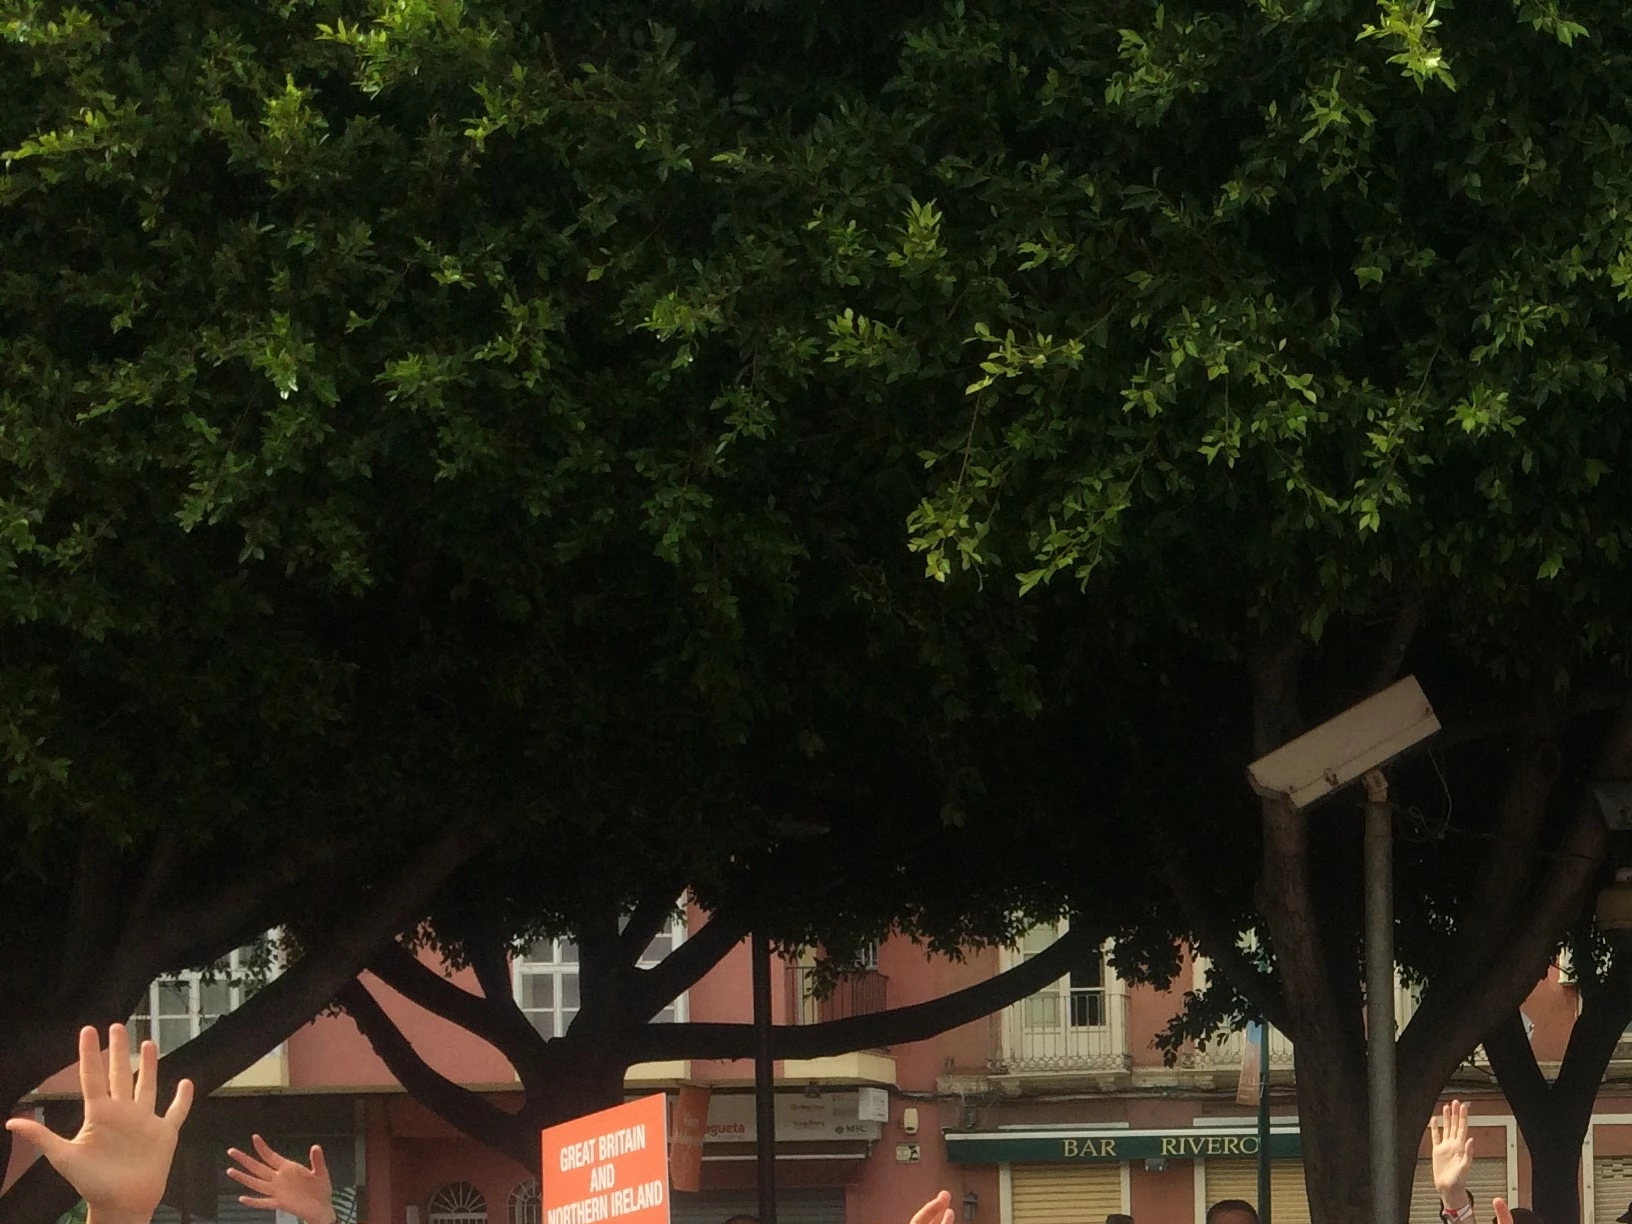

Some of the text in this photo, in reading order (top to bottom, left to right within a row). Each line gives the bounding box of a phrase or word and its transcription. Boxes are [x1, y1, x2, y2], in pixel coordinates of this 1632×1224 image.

[704, 1122, 745, 1137] agueta
[559, 1123, 646, 1172] GREAT BRITAIN
[1062, 1136, 1261, 1158] BAR RIVERO
[589, 1162, 615, 1193] AND
[611, 1179, 663, 1217] IRELAND
